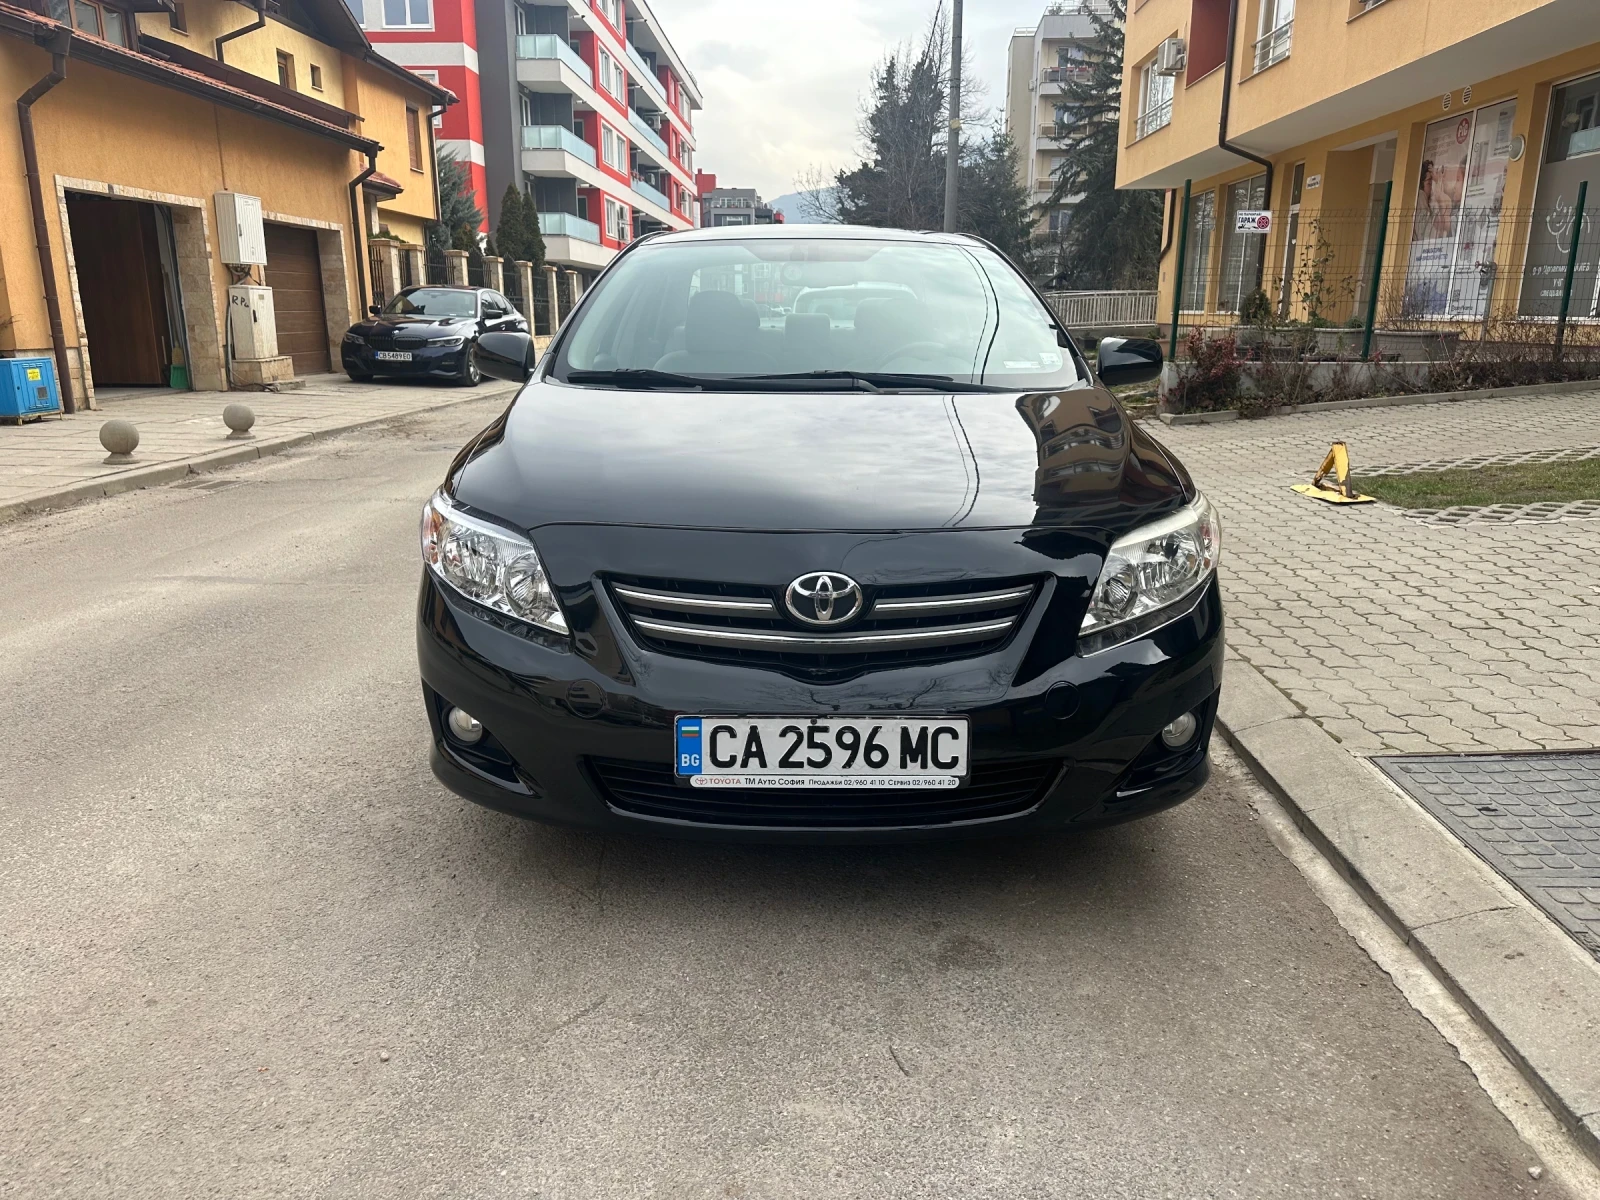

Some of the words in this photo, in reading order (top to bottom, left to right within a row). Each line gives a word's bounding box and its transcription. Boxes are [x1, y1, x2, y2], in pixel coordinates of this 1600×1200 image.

[709, 725, 768, 769] CA
[778, 725, 889, 769] 2596
[900, 726, 960, 769] MC
[681, 753, 700, 767] BG
[709, 777, 742, 785] TOYOTA
